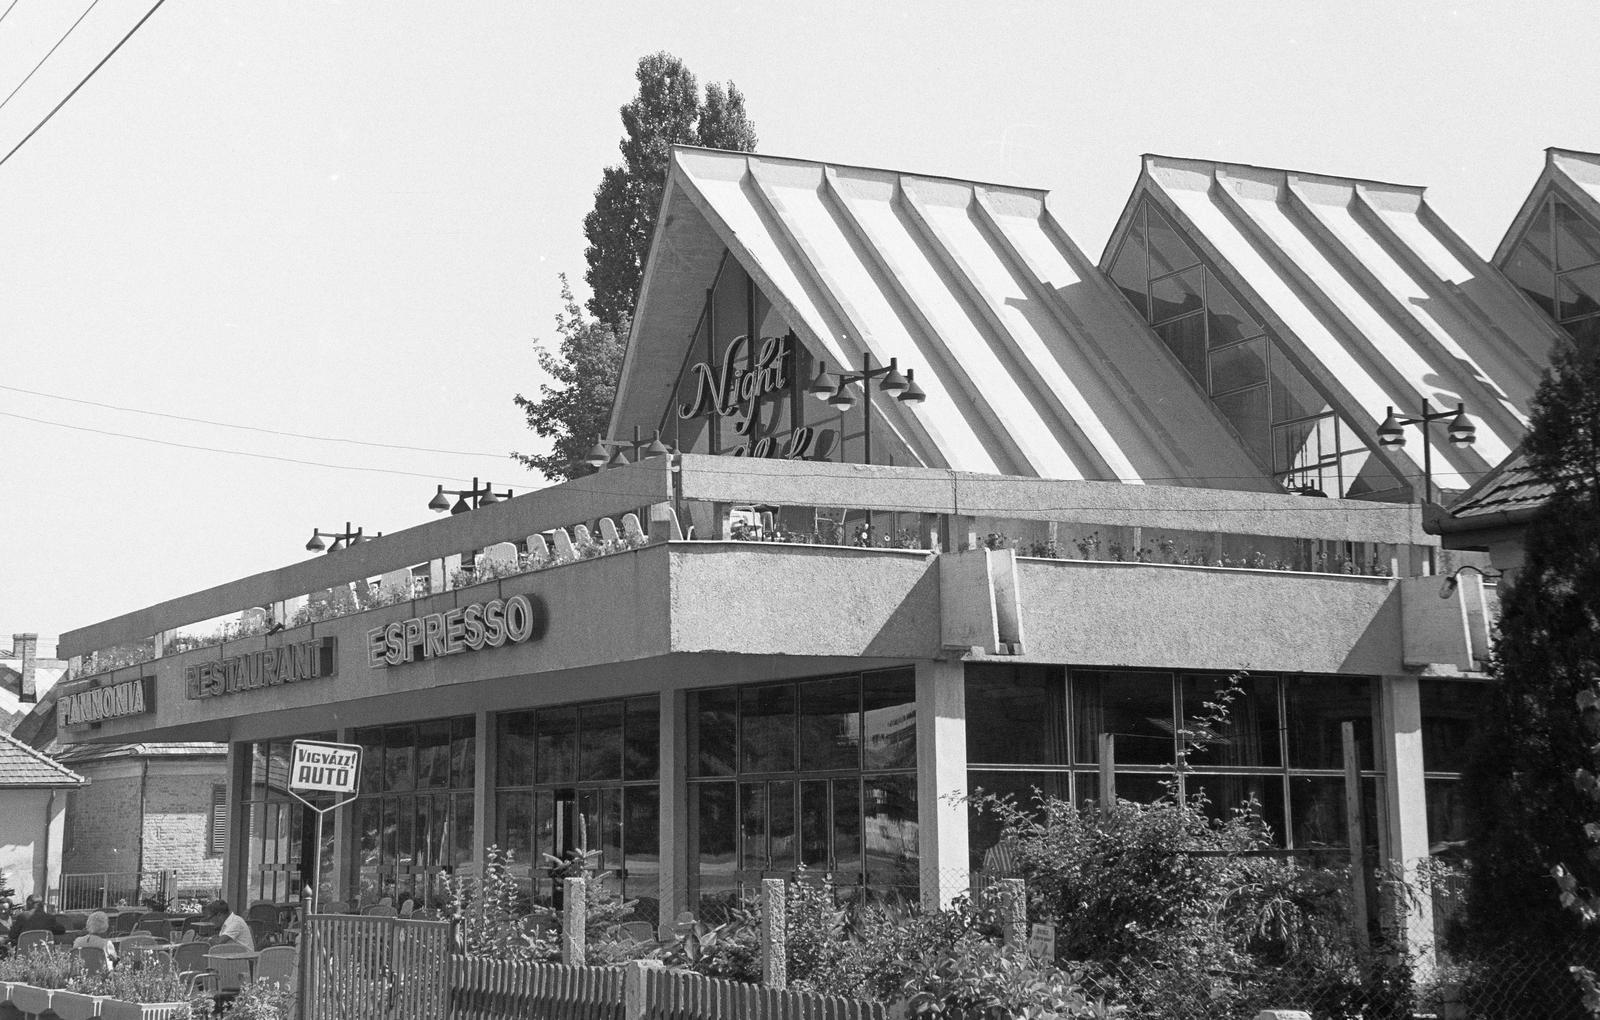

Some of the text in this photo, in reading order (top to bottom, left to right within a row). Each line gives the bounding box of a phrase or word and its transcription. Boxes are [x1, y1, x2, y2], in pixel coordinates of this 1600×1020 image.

[678, 334, 791, 435] Night
[57, 594, 534, 727] PANNONIA RESTAURANT ESPRESSO
[298, 749, 357, 769] VIGYÁZZ!
